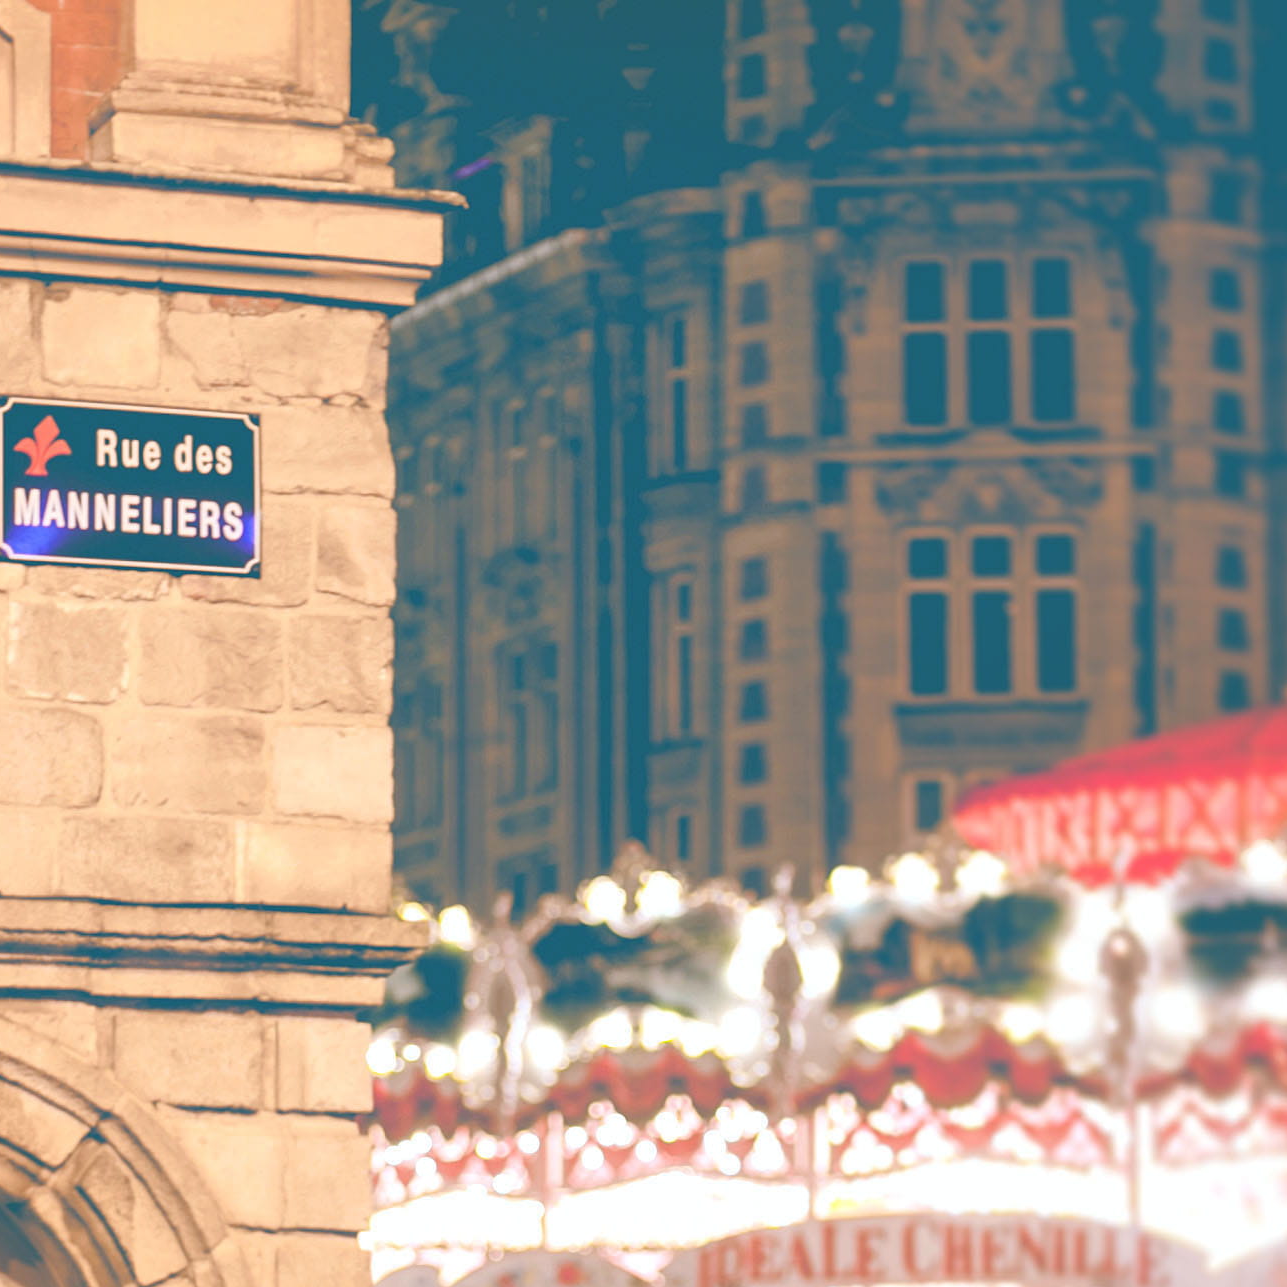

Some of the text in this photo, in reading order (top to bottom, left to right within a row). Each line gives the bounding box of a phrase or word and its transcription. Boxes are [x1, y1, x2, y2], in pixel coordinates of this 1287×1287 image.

[96, 428, 233, 475] Rue des
[13, 487, 244, 541] MANNELIERS
